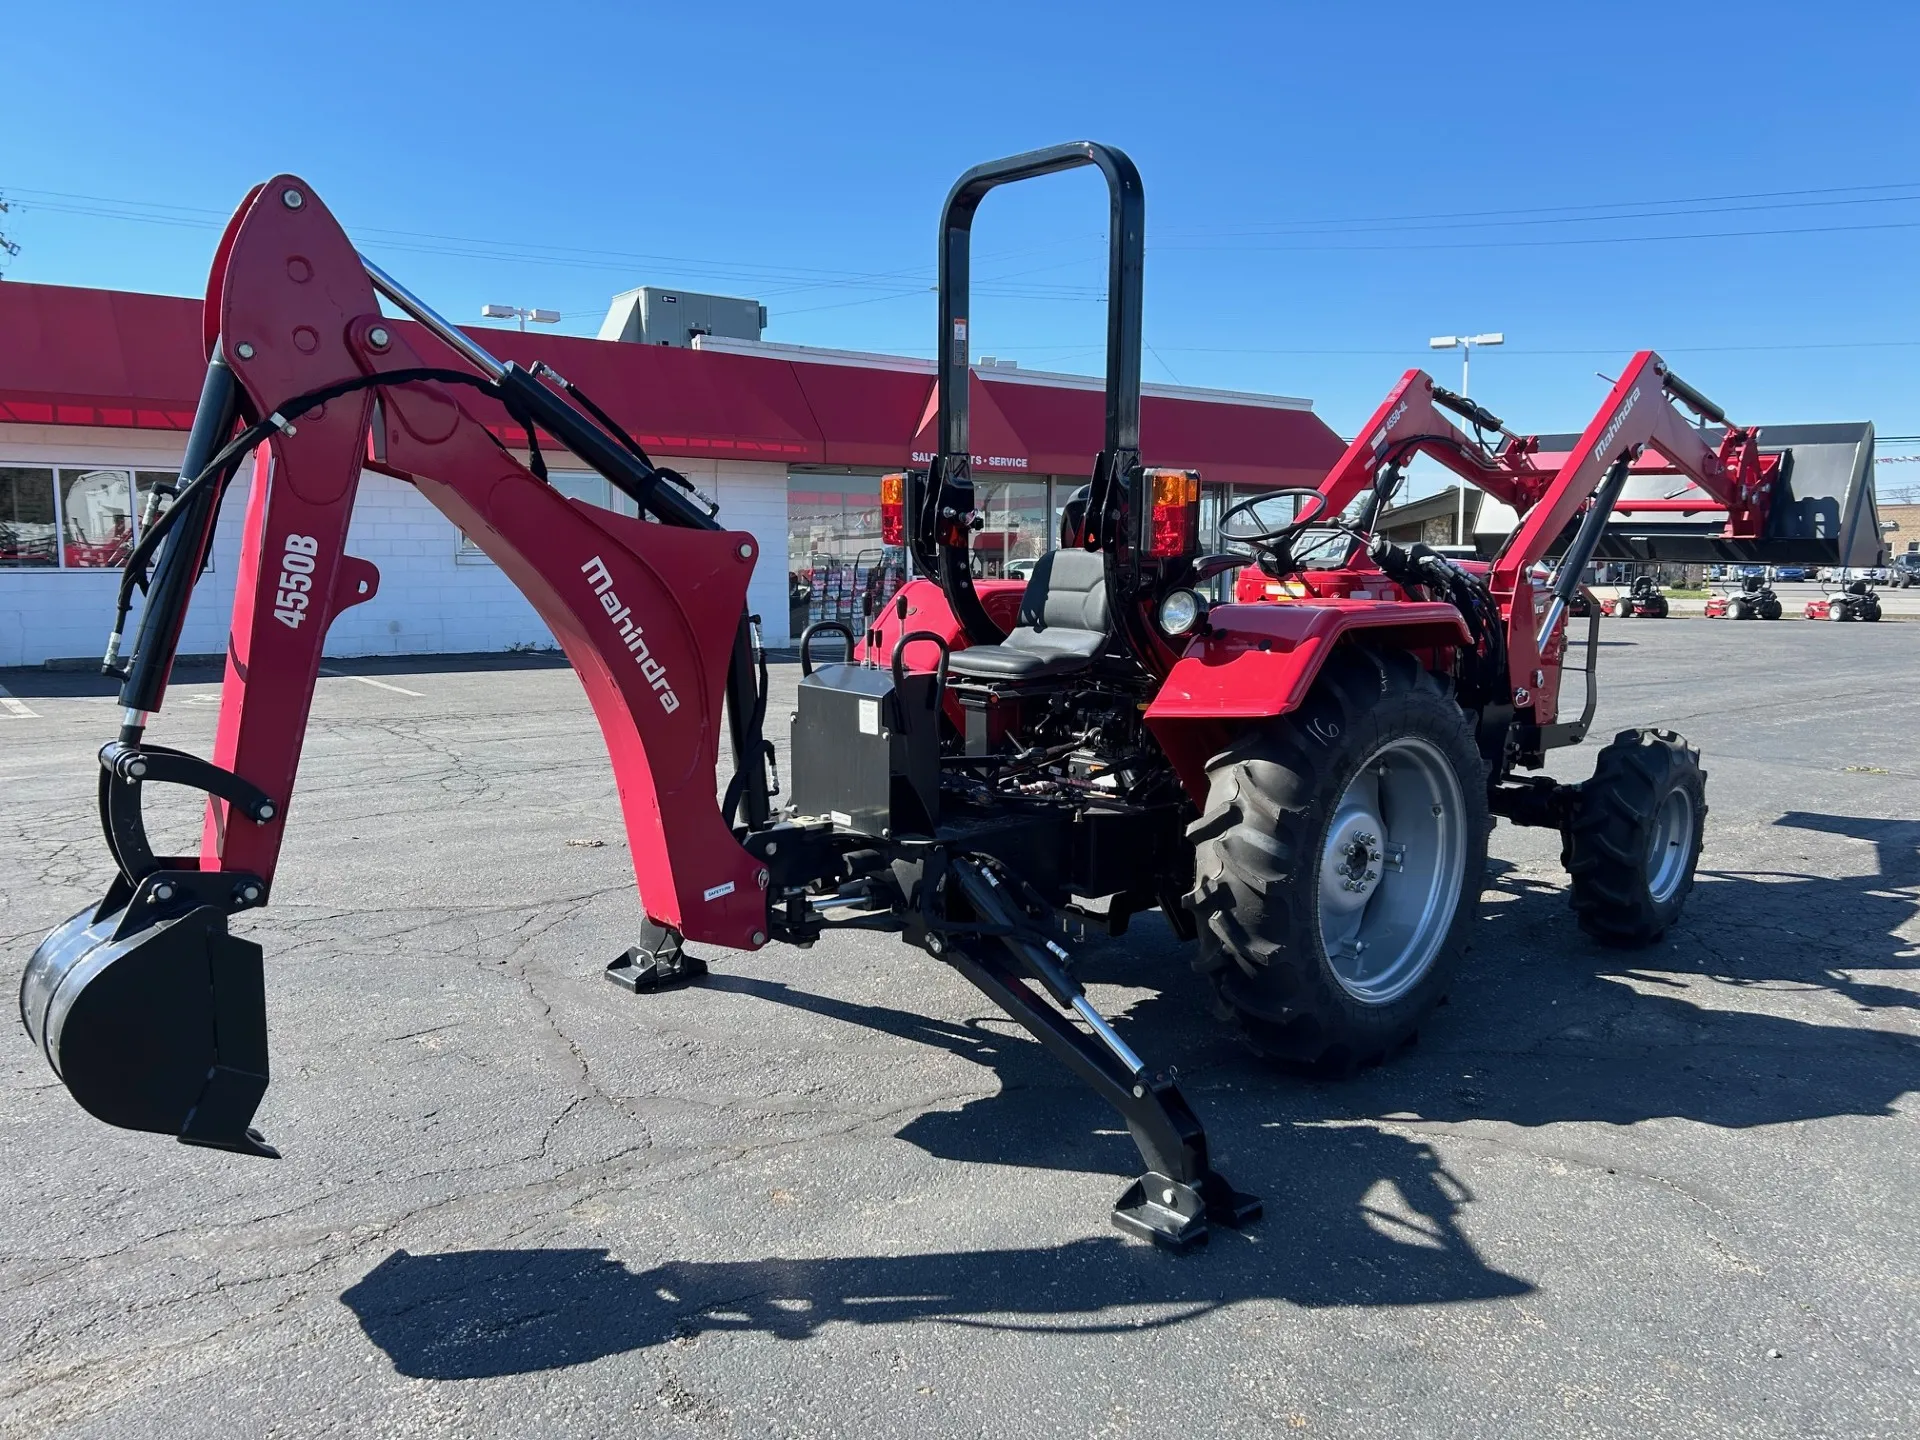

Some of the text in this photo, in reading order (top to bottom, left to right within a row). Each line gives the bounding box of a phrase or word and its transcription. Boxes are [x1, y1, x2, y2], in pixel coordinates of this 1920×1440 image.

[988, 456, 1028, 468] SERVICE
[273, 533, 319, 629] 4550B
[1306, 717, 1340, 747] 16
